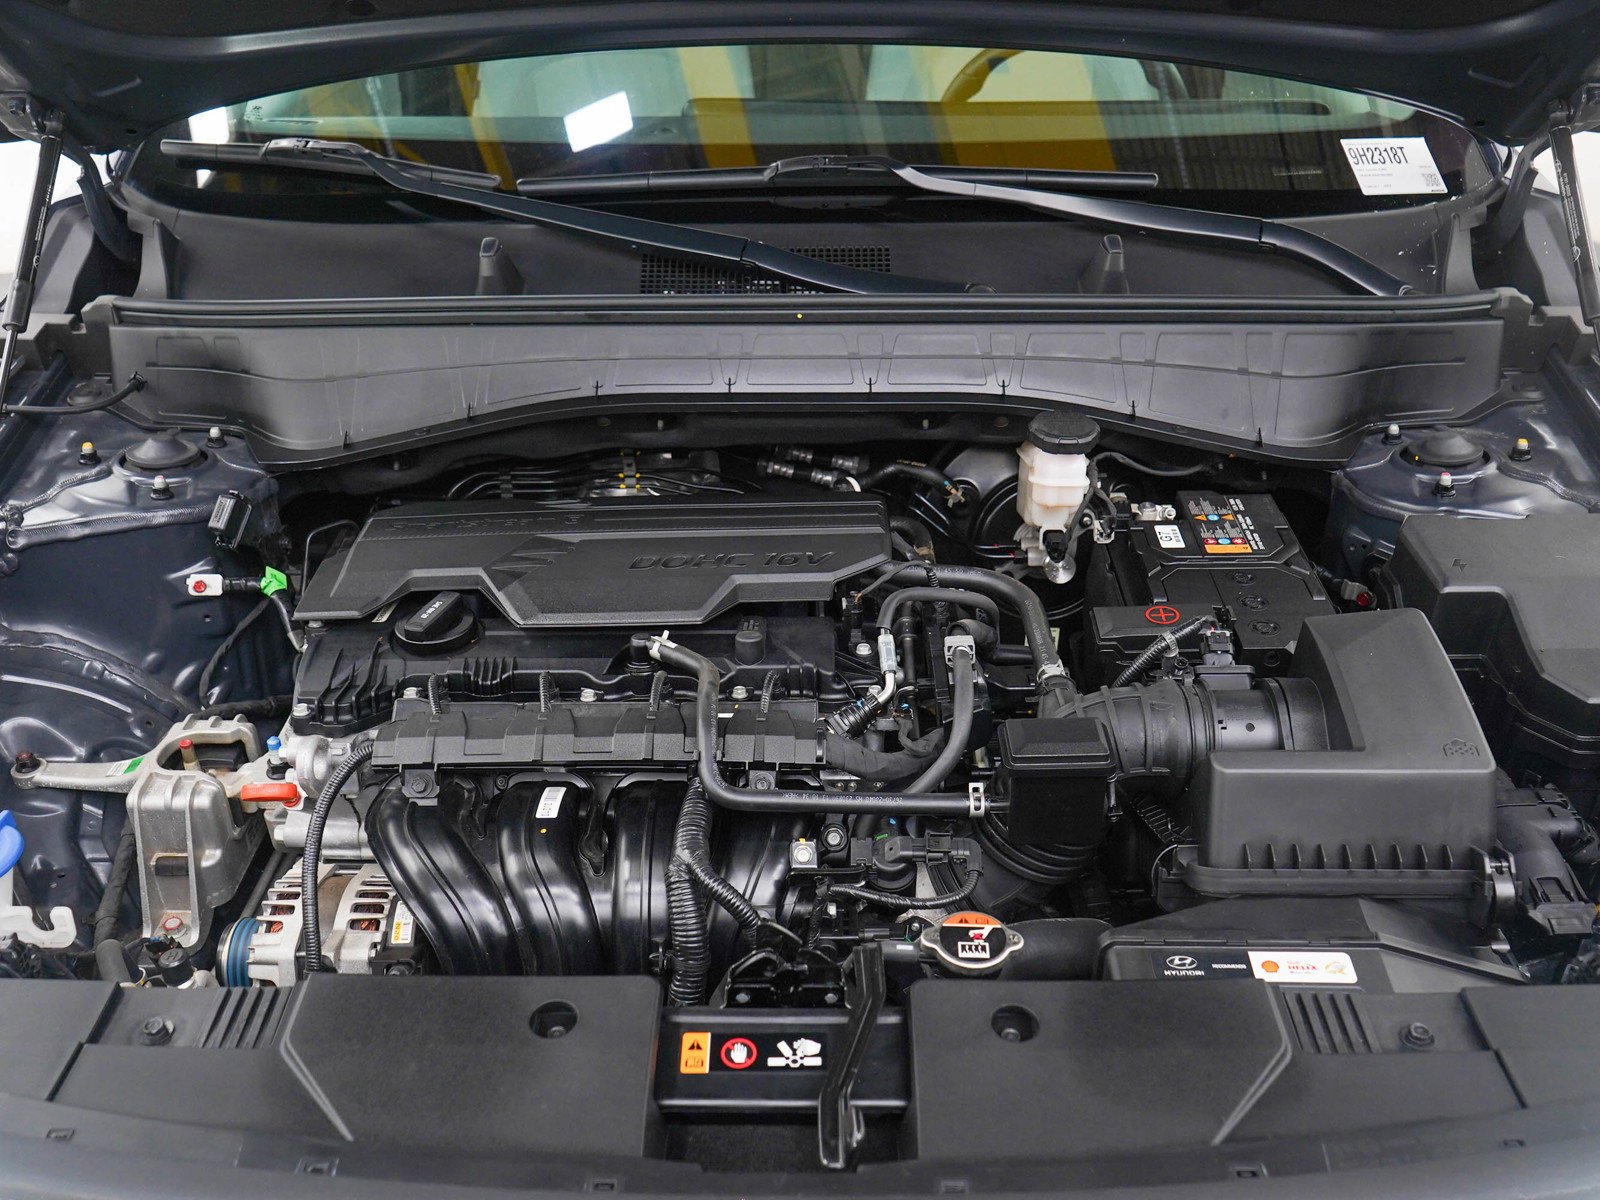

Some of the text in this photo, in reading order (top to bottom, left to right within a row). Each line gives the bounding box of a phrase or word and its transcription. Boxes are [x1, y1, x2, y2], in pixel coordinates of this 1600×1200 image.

[1347, 147, 1408, 165] 9H2318T
[628, 551, 837, 570] DOHC 16V
